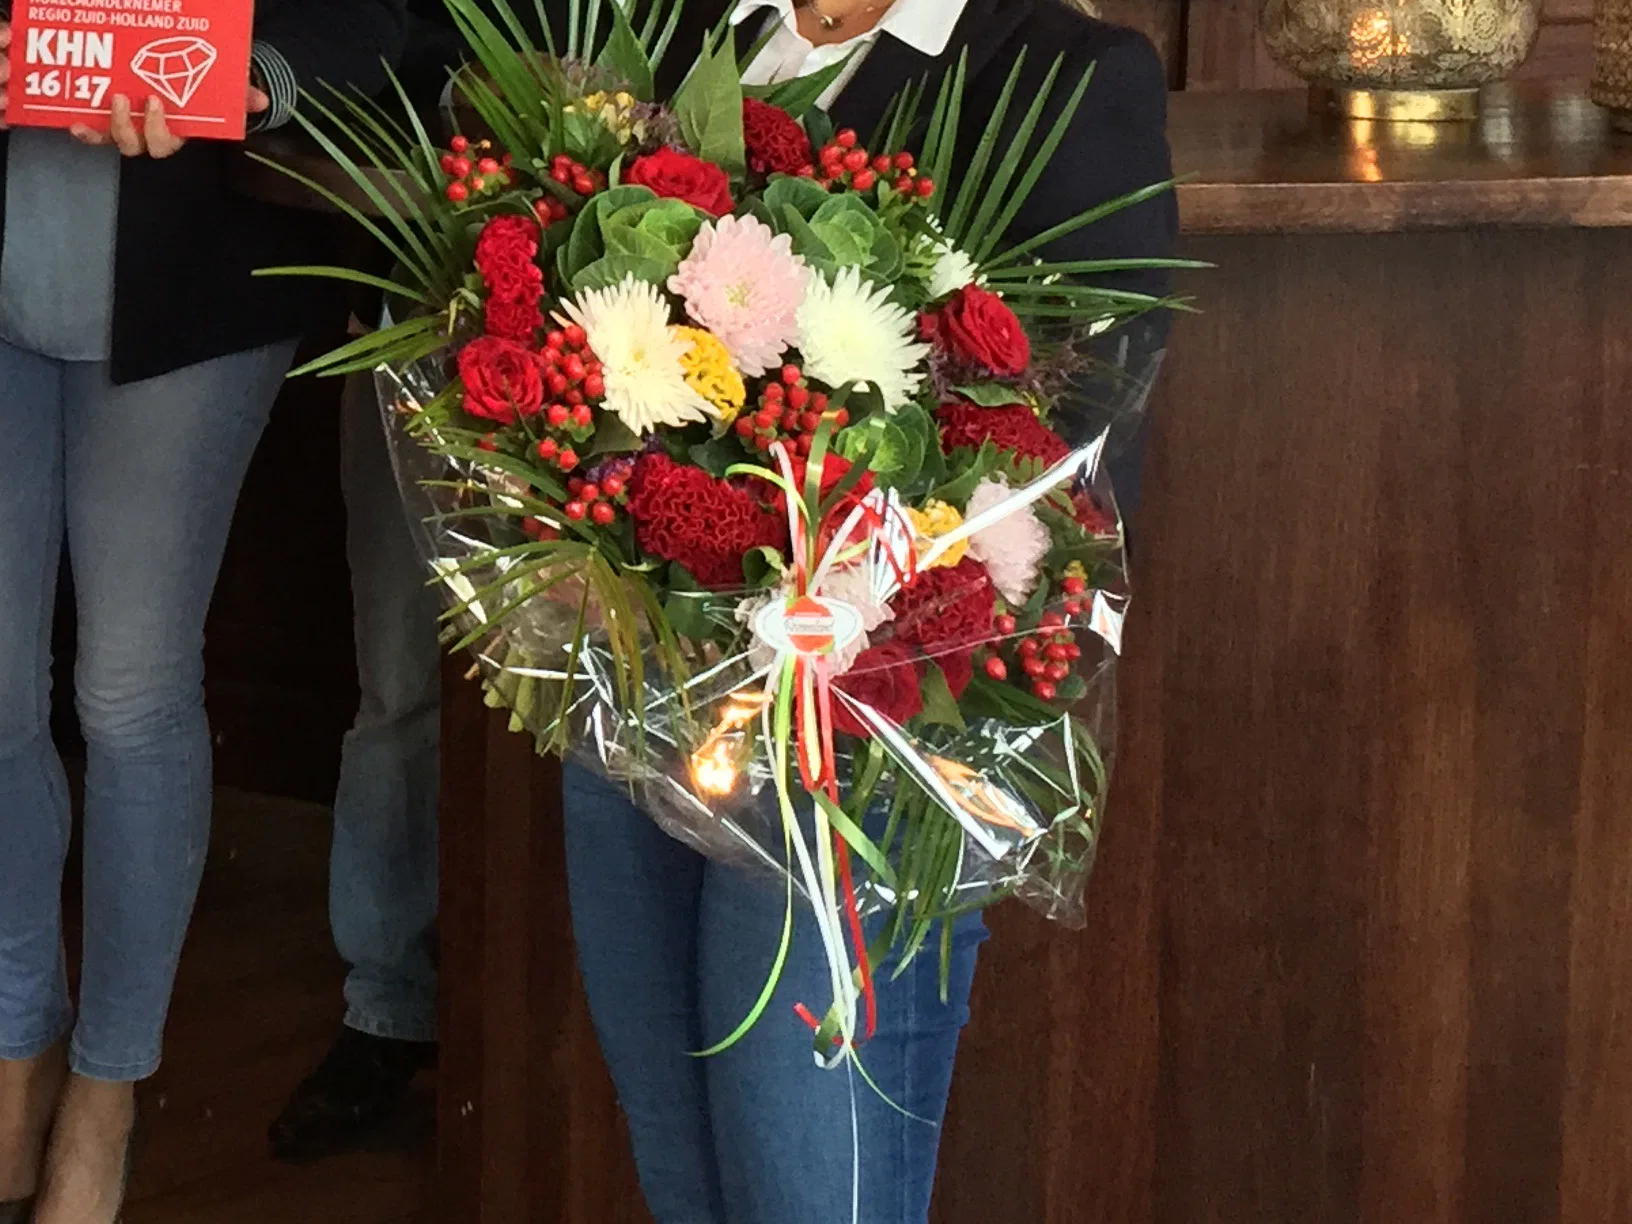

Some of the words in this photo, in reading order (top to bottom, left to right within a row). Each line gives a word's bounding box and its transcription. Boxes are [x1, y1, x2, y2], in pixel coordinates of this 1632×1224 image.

[28, 7, 71, 23] REGIO
[176, 17, 210, 32] ZUID
[25, 27, 115, 69] KHN
